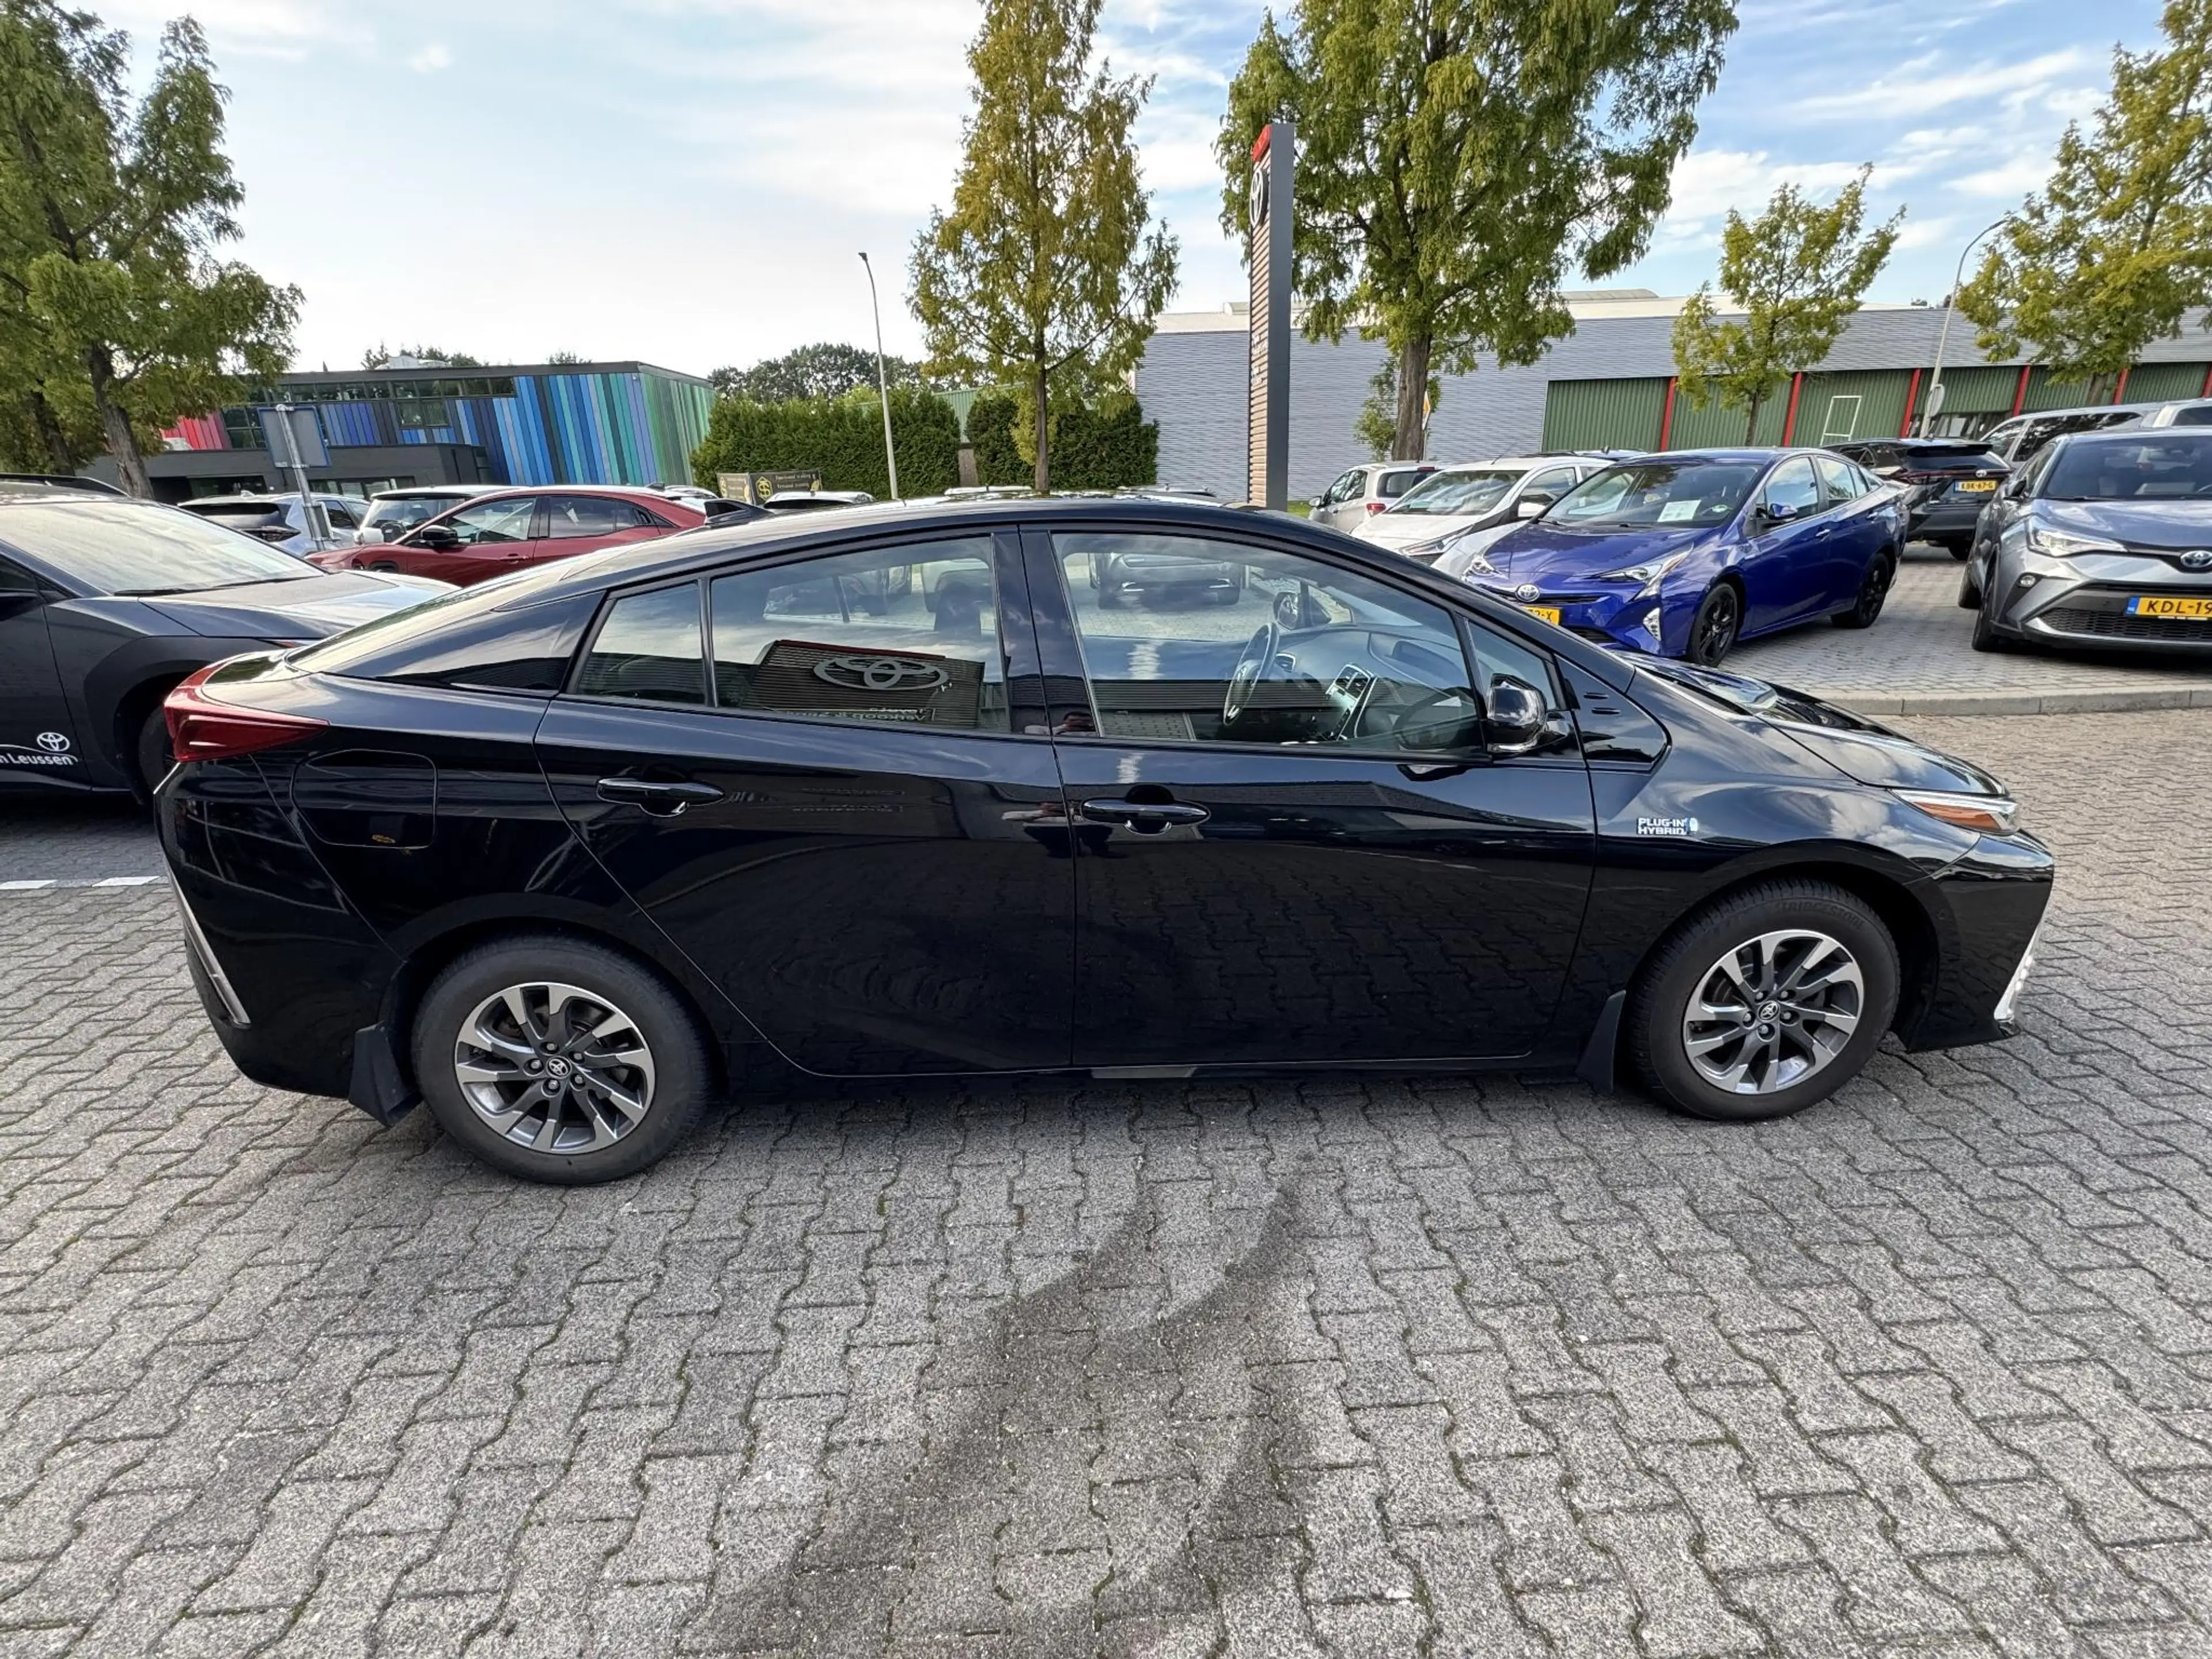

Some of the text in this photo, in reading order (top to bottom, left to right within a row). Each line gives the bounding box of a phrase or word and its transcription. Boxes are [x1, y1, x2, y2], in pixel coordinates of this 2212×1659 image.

[6, 753, 74, 766] Leussen
[1638, 818, 1684, 827] PLUG-IN
[1638, 827, 1685, 835] HYBRID
